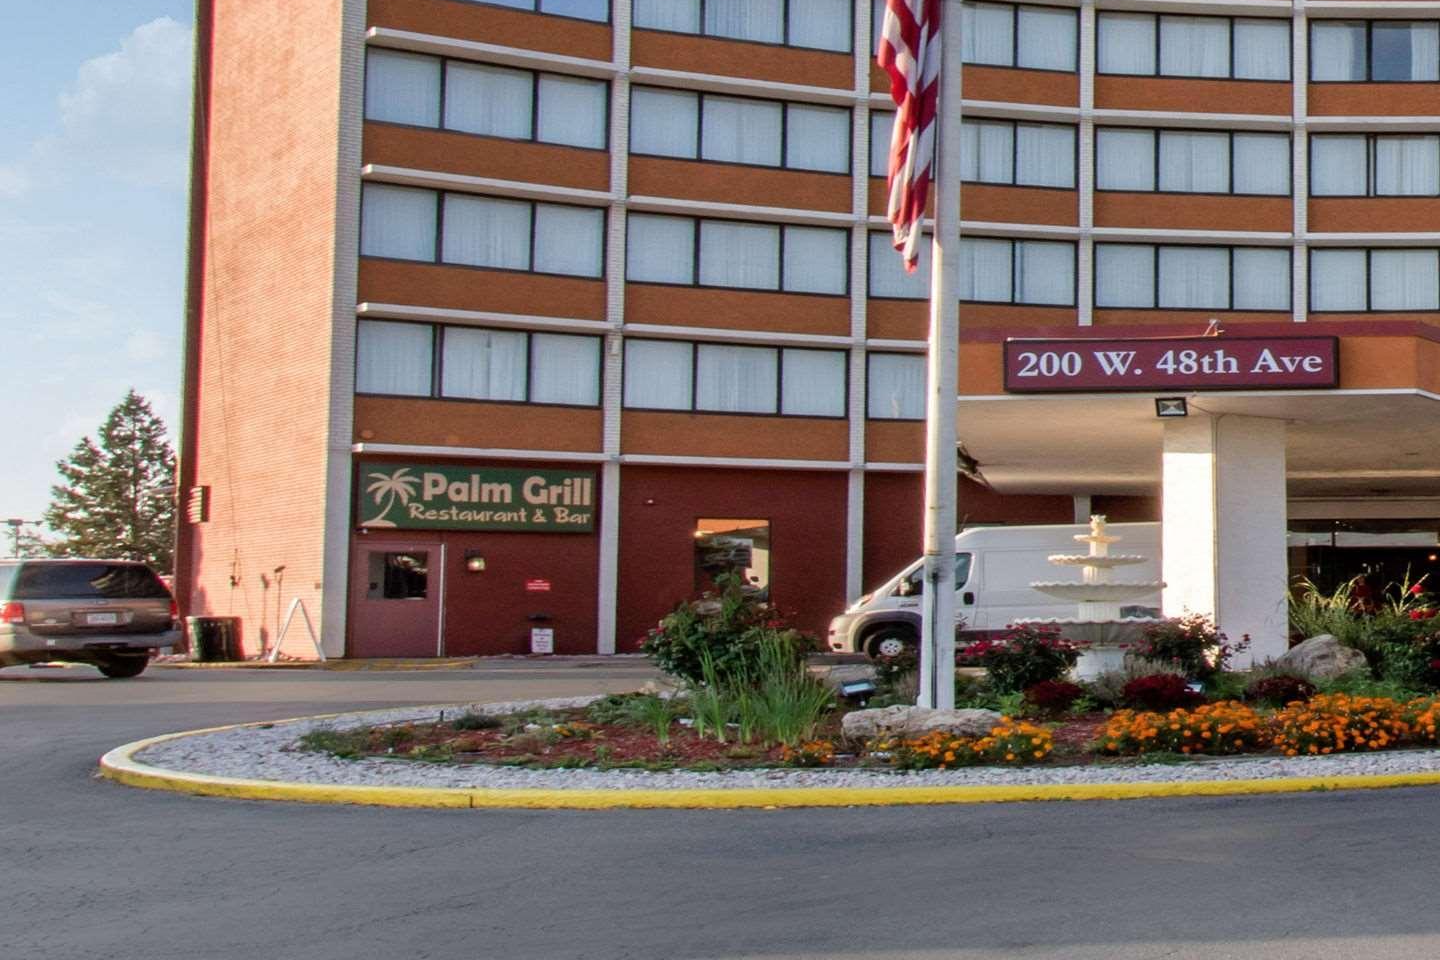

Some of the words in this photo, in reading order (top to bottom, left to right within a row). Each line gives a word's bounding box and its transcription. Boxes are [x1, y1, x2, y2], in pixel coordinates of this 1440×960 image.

[1016, 351, 1082, 377] 200
[1094, 350, 1143, 376] W.
[1155, 349, 1240, 375] 48th
[1250, 348, 1323, 374] Ave
[422, 472, 513, 504] Palm
[522, 475, 592, 506] Grill
[408, 502, 527, 523] Restaurant
[532, 508, 548, 524] &
[553, 506, 592, 525] Bar
